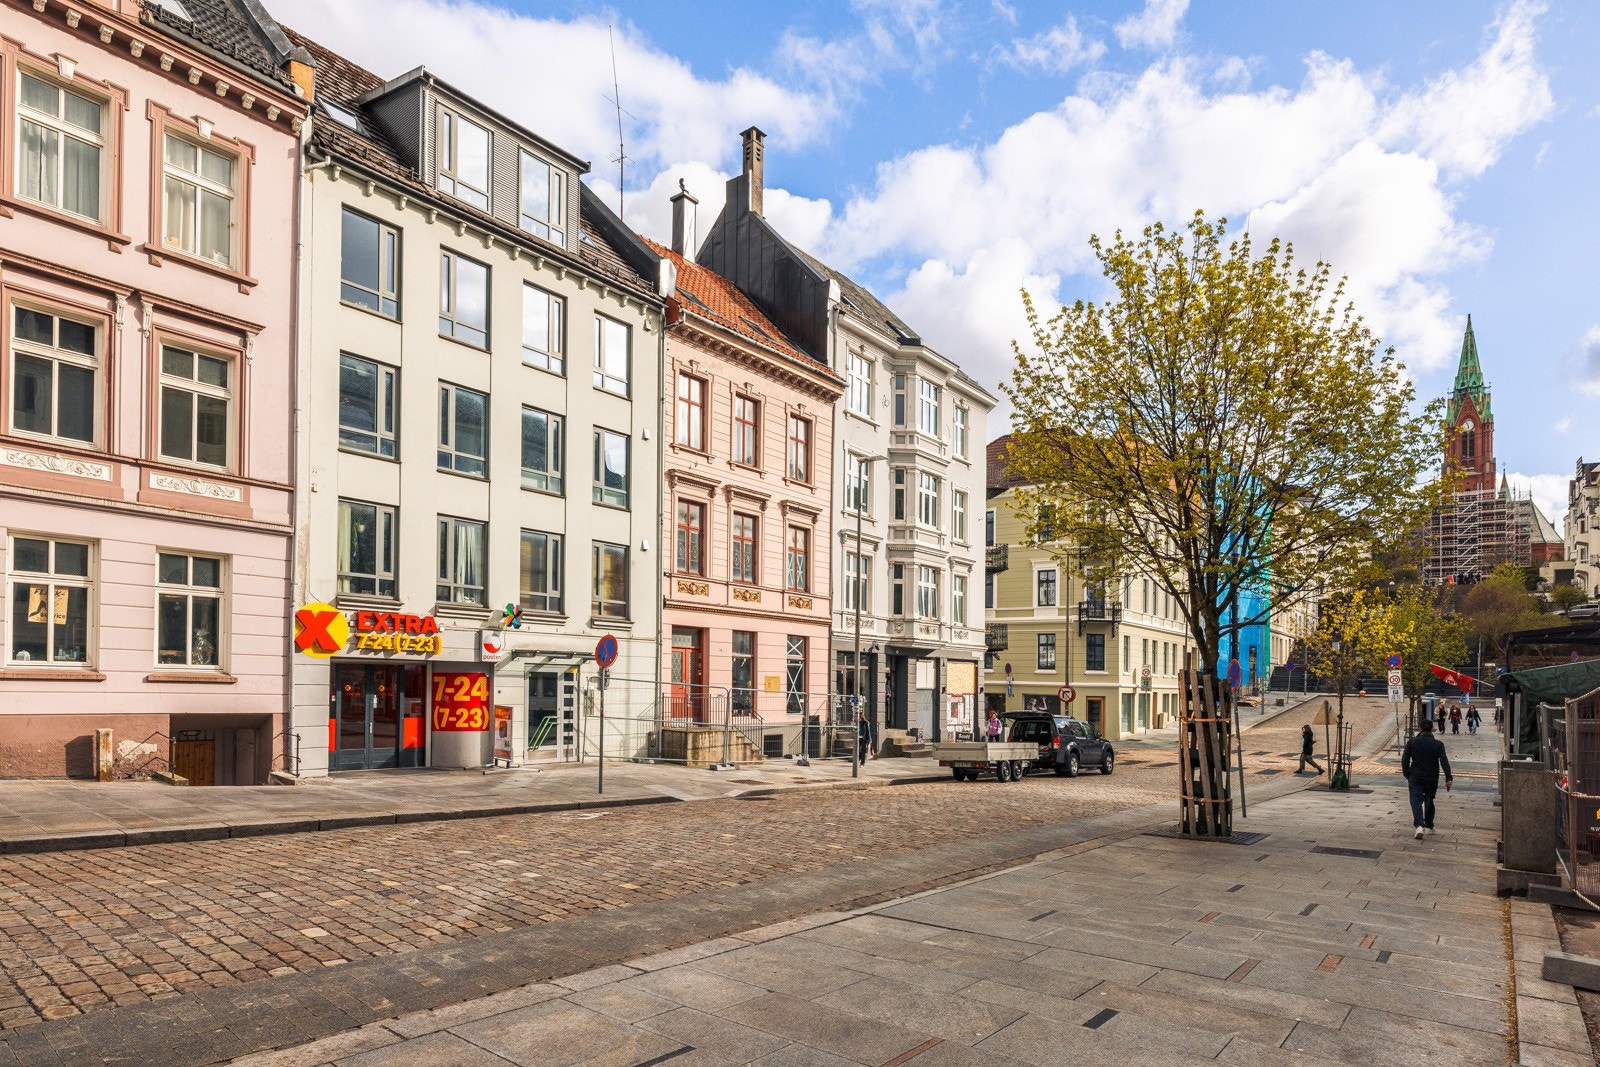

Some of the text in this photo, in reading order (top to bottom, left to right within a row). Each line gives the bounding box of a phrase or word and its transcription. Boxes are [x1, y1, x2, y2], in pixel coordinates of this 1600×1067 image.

[295, 609, 341, 650] X
[356, 610, 438, 633] EXTRA
[356, 633, 442, 655] 7-24 (7-23)
[433, 676, 489, 701] 7-24
[434, 706, 489, 729] (7-23)
